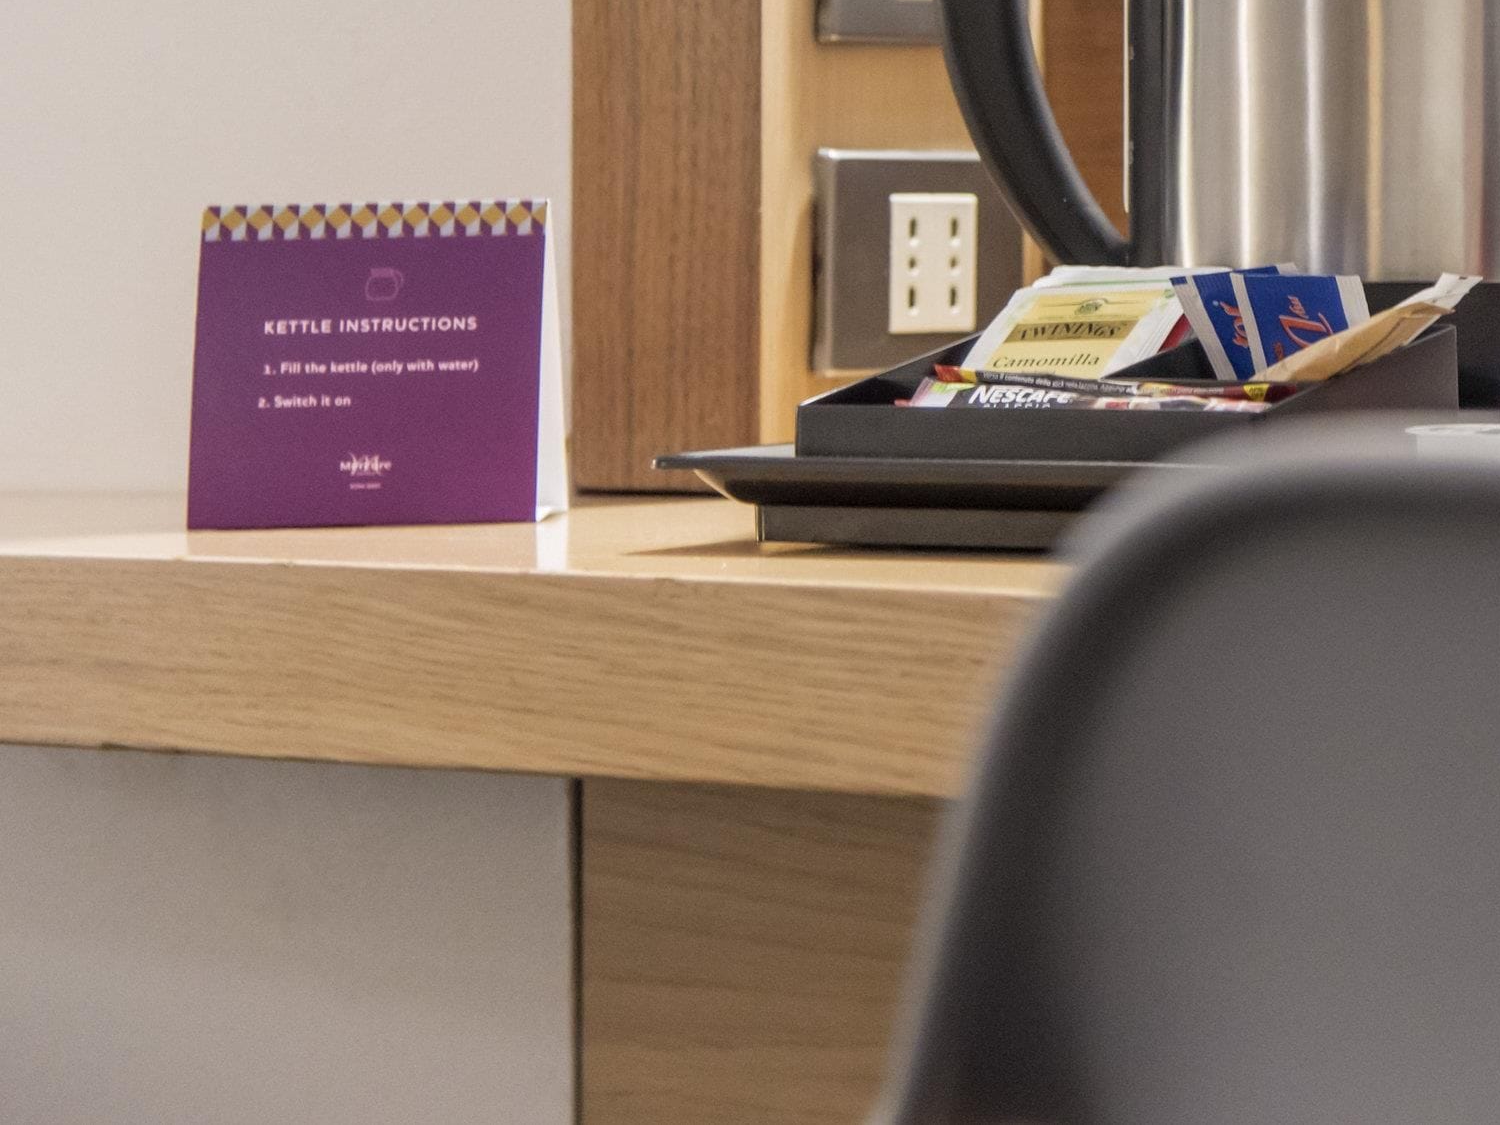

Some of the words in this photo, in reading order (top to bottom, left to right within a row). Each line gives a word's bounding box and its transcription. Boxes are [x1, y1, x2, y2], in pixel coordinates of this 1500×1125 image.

[264, 319, 332, 335] KETTLE
[339, 315, 478, 333] INSTRUCTIONS
[1018, 322, 1122, 341] TWININGS
[264, 364, 277, 375] 1.
[280, 361, 301, 375] Fill
[305, 361, 327, 374] the
[331, 361, 368, 373] kettle
[371, 359, 403, 374] (only
[407, 358, 434, 372] with
[438, 358, 479, 373] water)
[993, 353, 1100, 369] Camomilla
[258, 397, 271, 409] 2.
[274, 395, 317, 409] Switch
[321, 395, 331, 407] it
[334, 396, 351, 407] on
